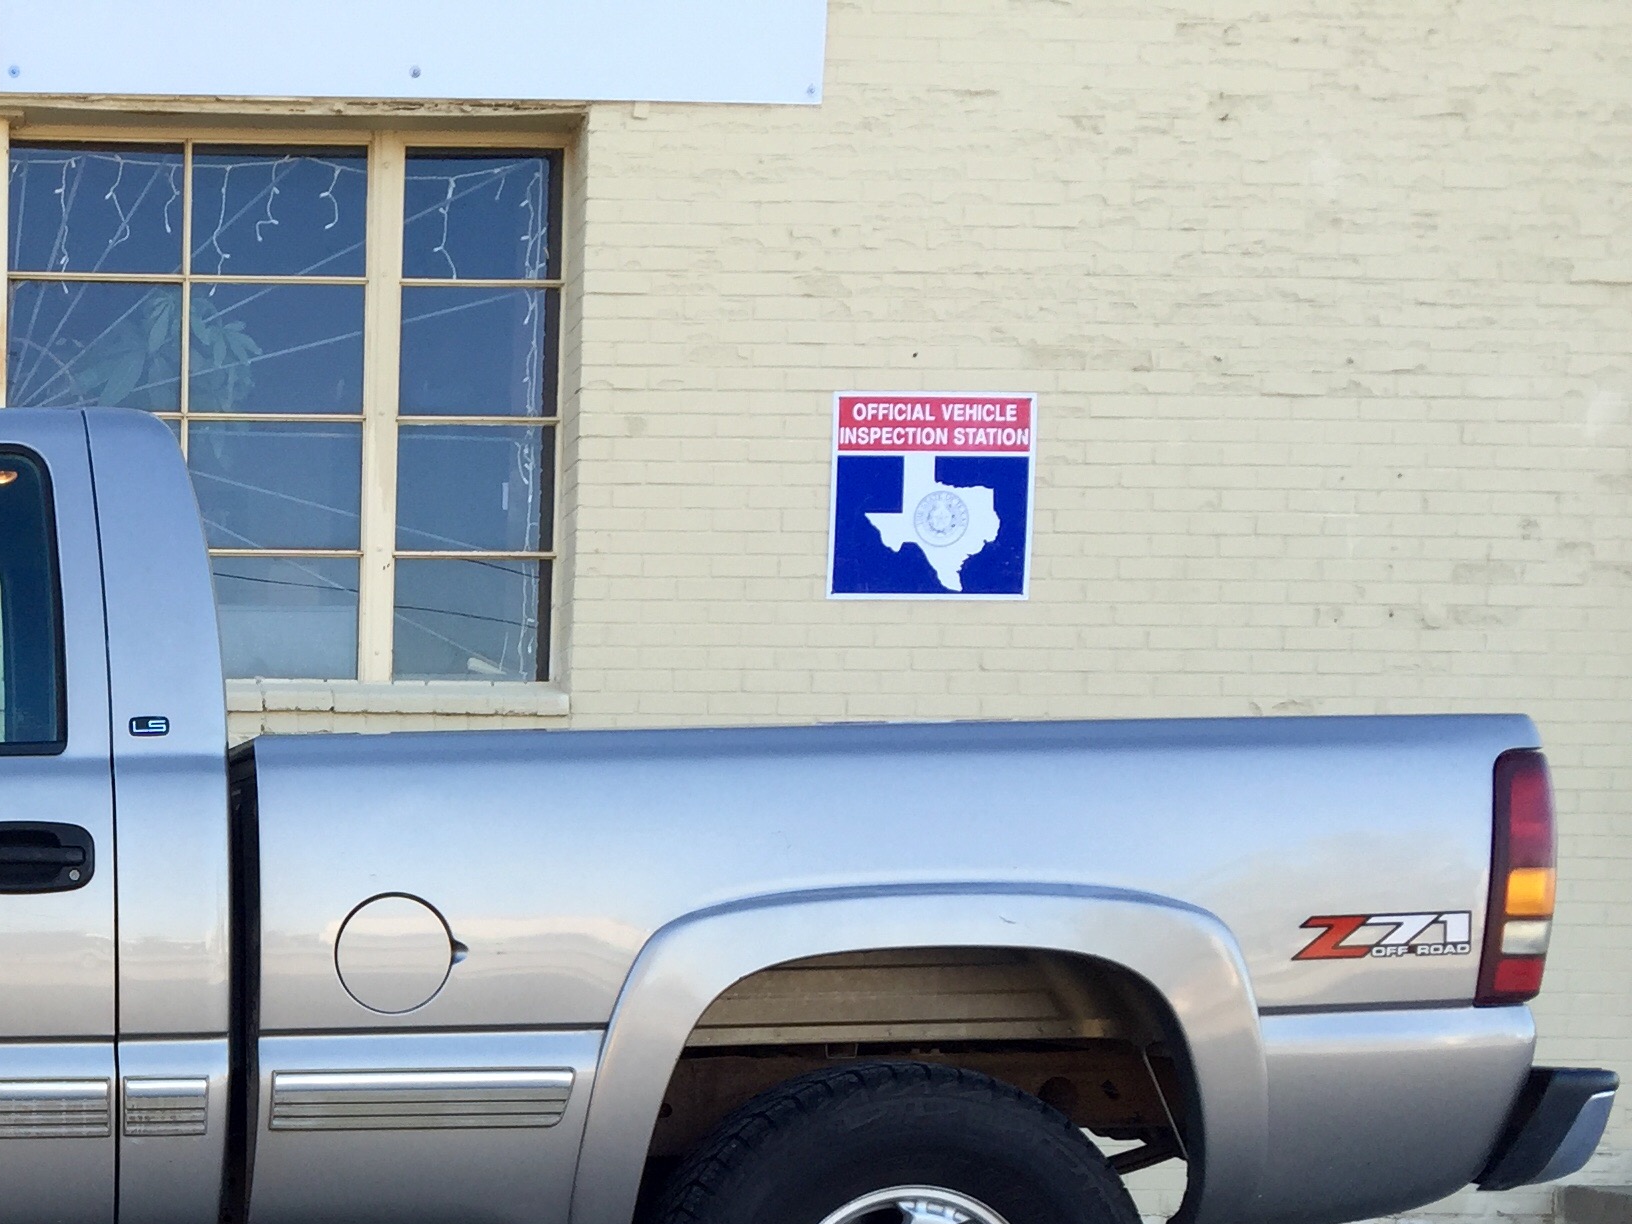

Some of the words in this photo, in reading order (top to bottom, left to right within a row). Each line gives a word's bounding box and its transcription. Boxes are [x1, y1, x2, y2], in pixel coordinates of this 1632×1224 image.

[852, 402, 936, 422] OFFICIAL
[941, 403, 1018, 422] VEHICLE
[839, 426, 948, 445] INSPECTION
[953, 427, 1030, 446] STATION
[132, 719, 167, 733] LS
[1291, 910, 1472, 961] Z71
[1371, 945, 1409, 957] OFF
[1416, 943, 1470, 956] ROAD
